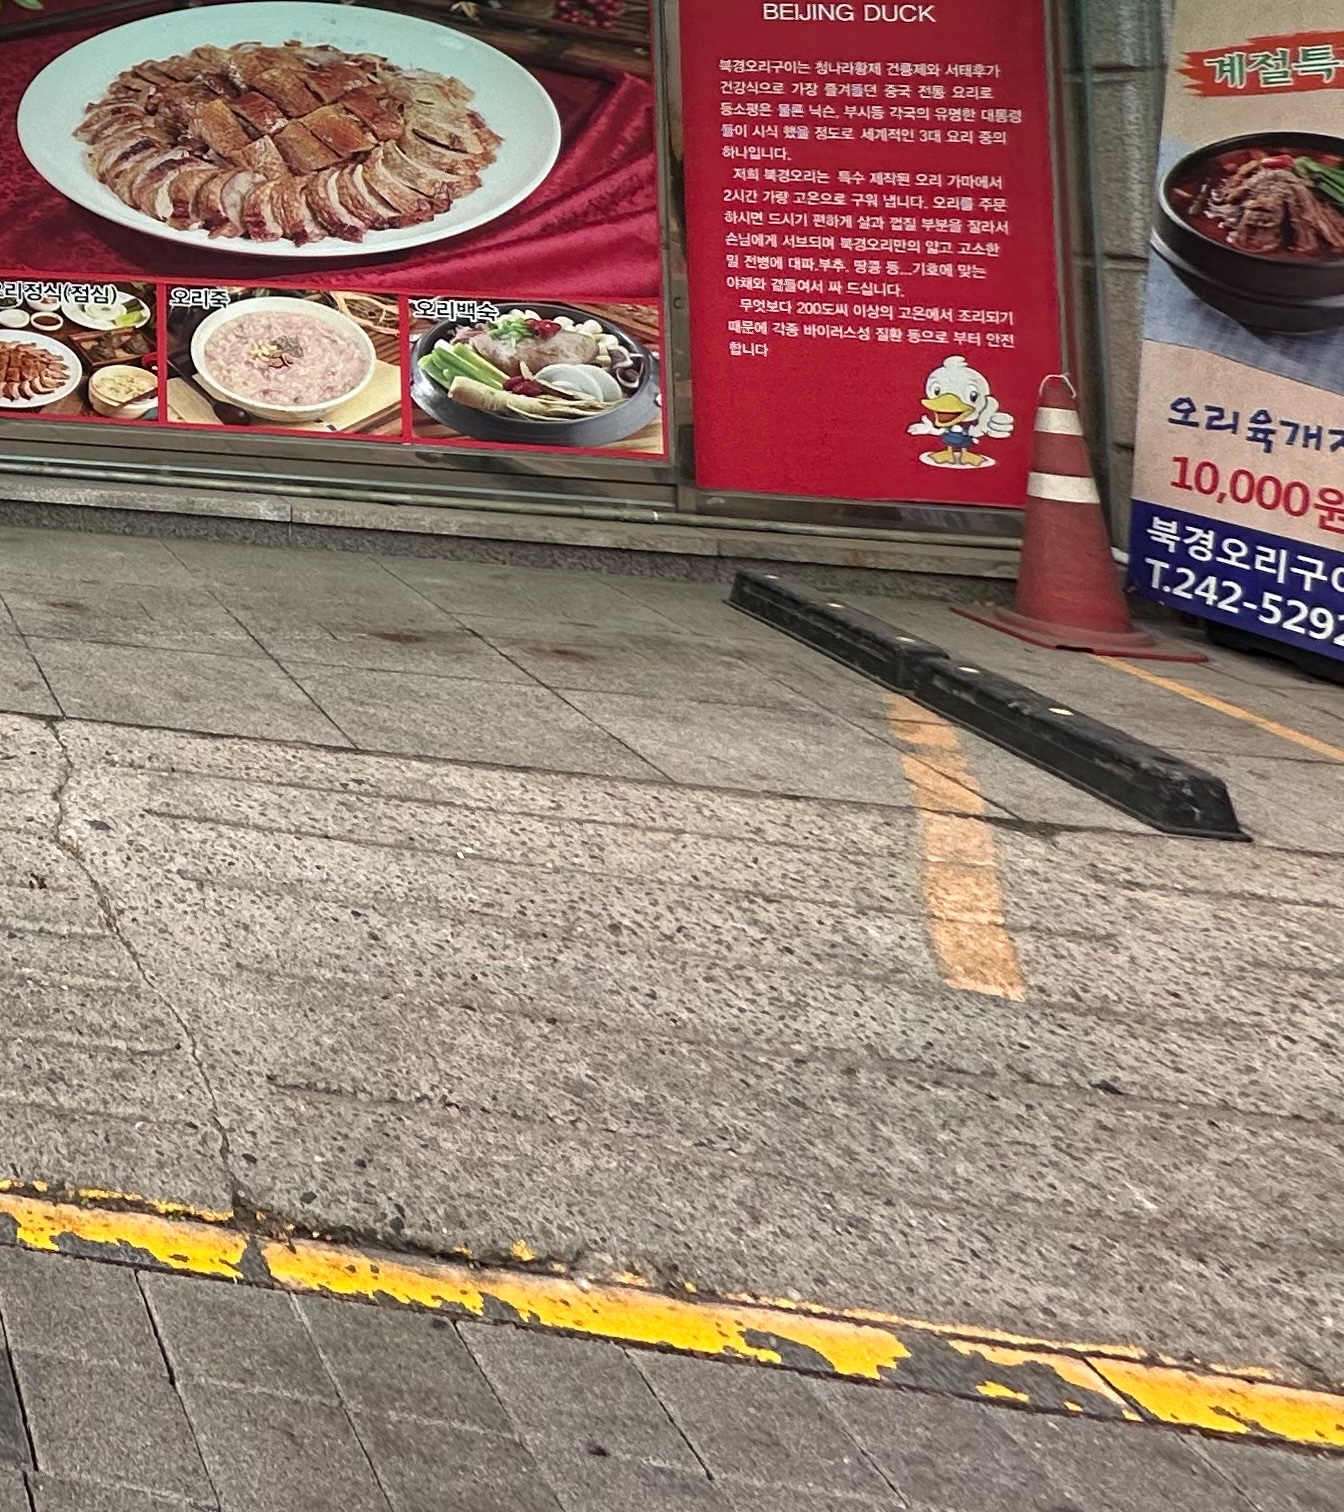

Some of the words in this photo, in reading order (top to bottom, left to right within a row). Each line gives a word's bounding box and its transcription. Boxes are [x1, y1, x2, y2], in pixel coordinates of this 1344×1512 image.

[762, 2, 855, 22] BEIJING
[863, 4, 937, 24] DUCK
[718, 59, 811, 75] 북경오리구이는
[1203, 44, 1344, 89] 계절특
[720, 80, 785, 95] 건강식으로
[791, 81, 819, 97] 가장
[884, 83, 912, 99] 중국
[951, 85, 995, 100] 요리로
[844, 105, 884, 120] 부시등
[889, 106, 930, 121] 각국의
[752, 124, 779, 139] 시식
[814, 126, 855, 141] 정도로
[860, 127, 915, 143] 세계적인
[946, 130, 974, 144] 요리
[978, 130, 1007, 145] 중의
[721, 145, 792, 161] 하나입니다.
[763, 168, 830, 184] 북경오리는
[837, 170, 865, 185] 특수
[915, 173, 942, 188] 오리
[723, 189, 758, 203] 2시간
[793, 191, 847, 206] 고온으로
[850, 193, 878, 208] 구워
[723, 210, 764, 225] 하시면
[768, 212, 808, 227] 드시기
[724, 232, 777, 248] 손님에게
[839, 236, 921, 254] 북경오리만의
[726, 276, 766, 291] 야채와
[168, 286, 229, 310] 오리죽
[414, 297, 498, 324] 오리백숙
[739, 298, 793, 314] 무엇보다
[796, 301, 849, 317] 200도씨
[853, 303, 893, 320] 이상의
[898, 306, 953, 323] 고온에서
[957, 308, 1014, 326] 조리되기
[803, 324, 871, 341] 바이러스성
[907, 328, 949, 344] 등으로
[953, 330, 981, 346] 부터
[985, 332, 1015, 349] 안전
[728, 340, 769, 358] 합니다
